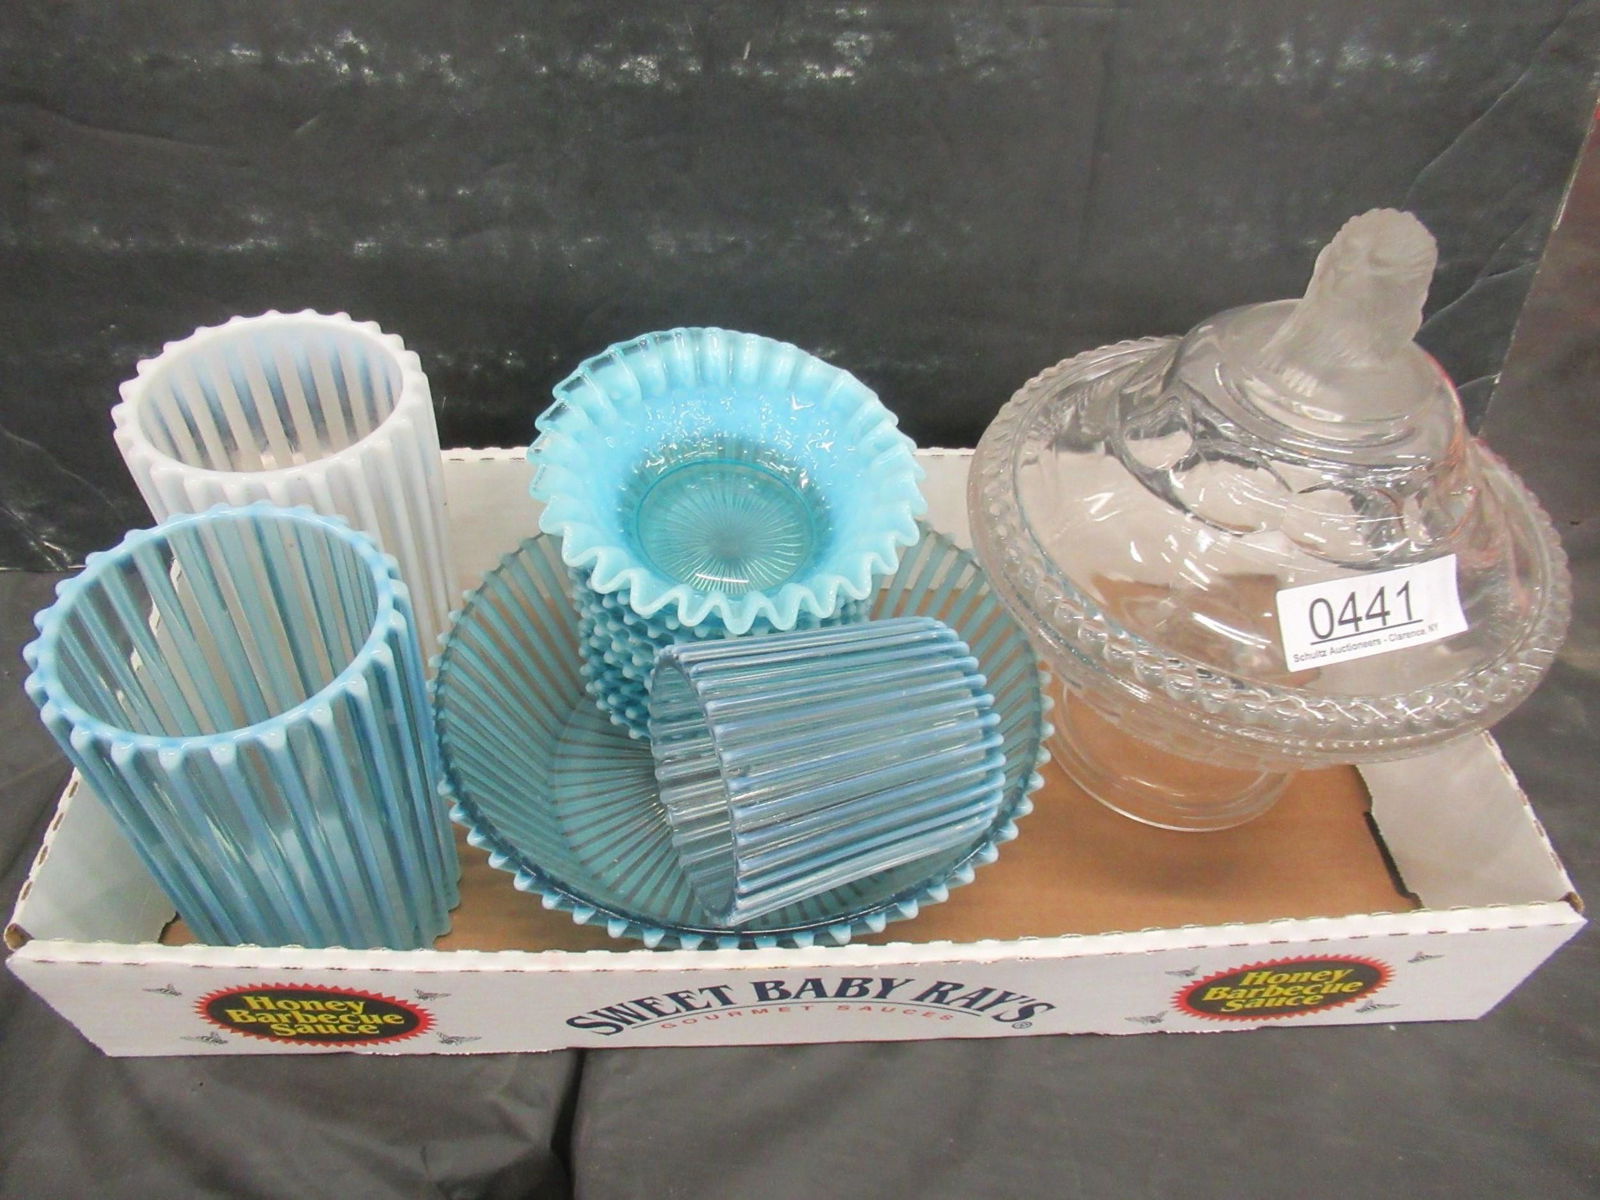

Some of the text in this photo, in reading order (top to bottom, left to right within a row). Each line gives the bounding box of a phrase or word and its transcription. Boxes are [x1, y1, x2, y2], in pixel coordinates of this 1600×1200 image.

[1309, 580, 1413, 640] 0441
[1293, 649, 1327, 663] Schultz
[1329, 639, 1382, 655] Auctioneers
[1239, 968, 1355, 987] Honey
[1202, 981, 1364, 1001] Barbecue
[242, 996, 366, 1015] Honey
[566, 977, 1056, 1036] SWEET BABY RAY'S
[1221, 993, 1325, 1012] Sauce
[224, 1009, 405, 1025] Barbecue
[660, 1004, 954, 1030] GOURMET SAUCES
[270, 1023, 380, 1037] Sauce
